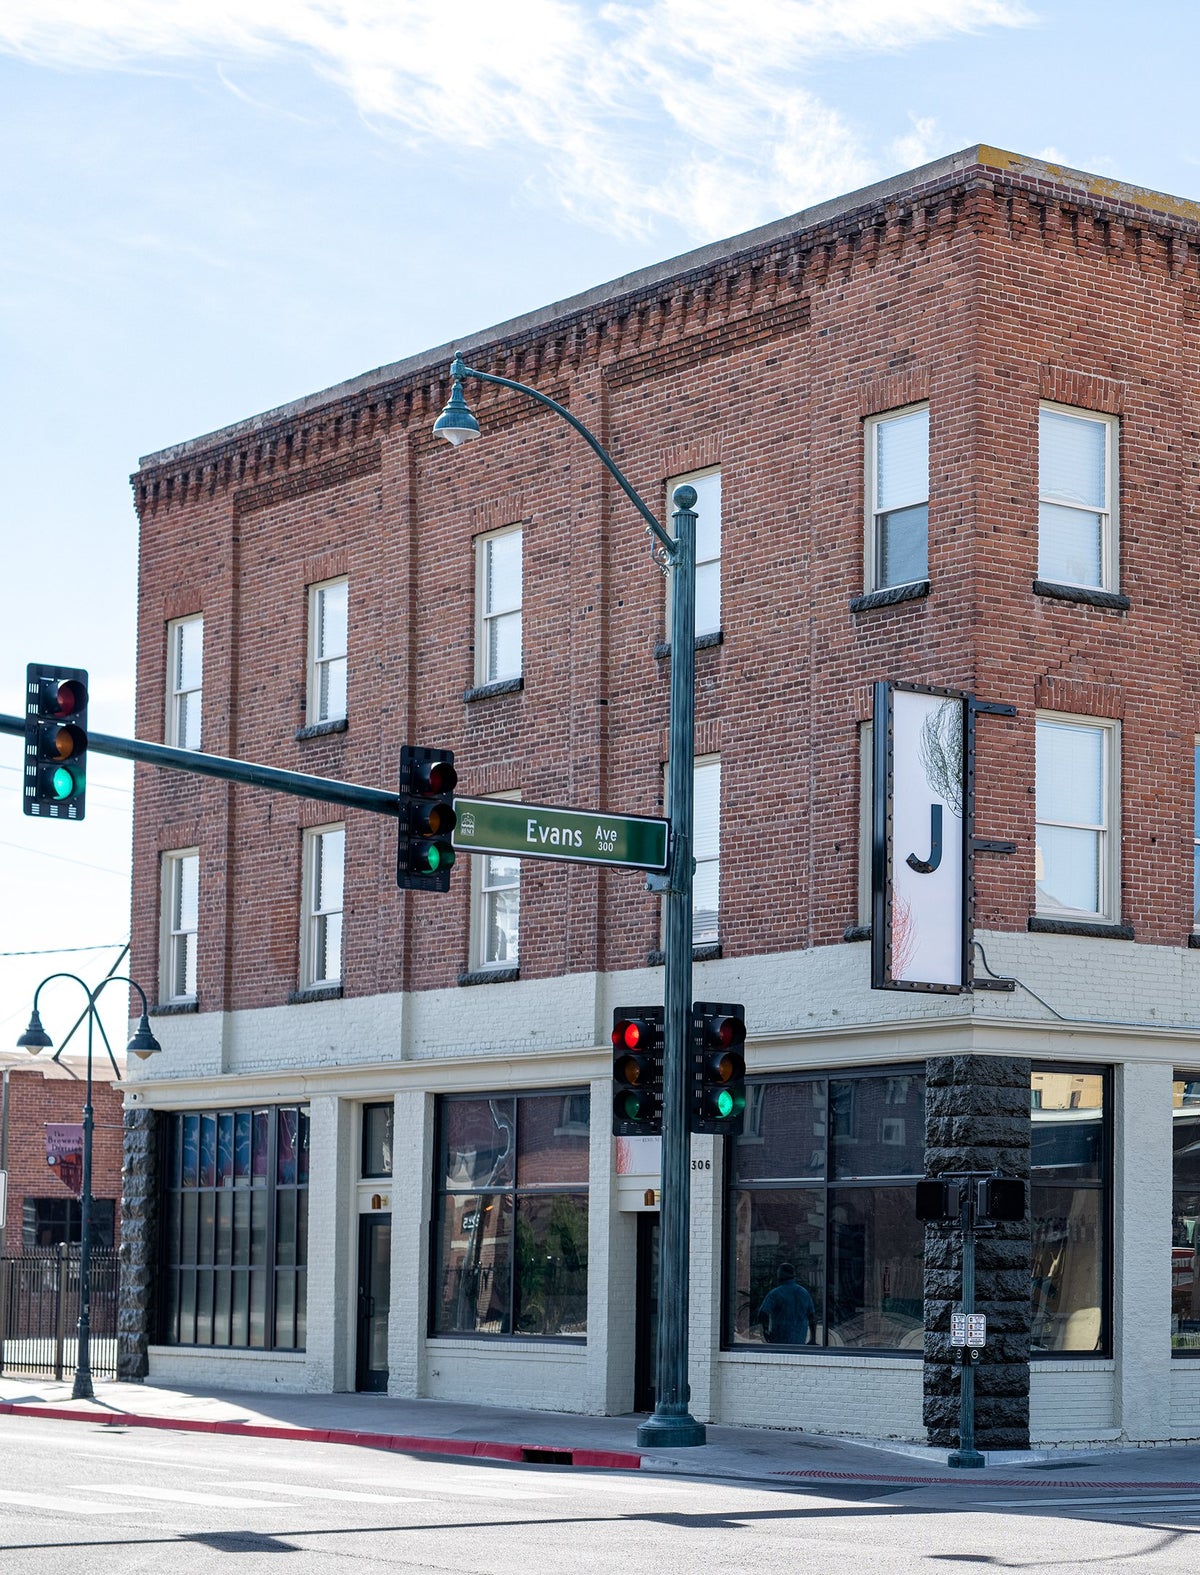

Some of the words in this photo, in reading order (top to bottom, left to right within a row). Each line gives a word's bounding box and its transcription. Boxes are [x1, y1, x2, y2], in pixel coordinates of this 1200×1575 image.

[526, 818, 583, 848] Evans
[595, 825, 618, 842] Ave
[905, 803, 943, 875] J
[598, 841, 614, 852] 300
[690, 1159, 711, 1170] 306
